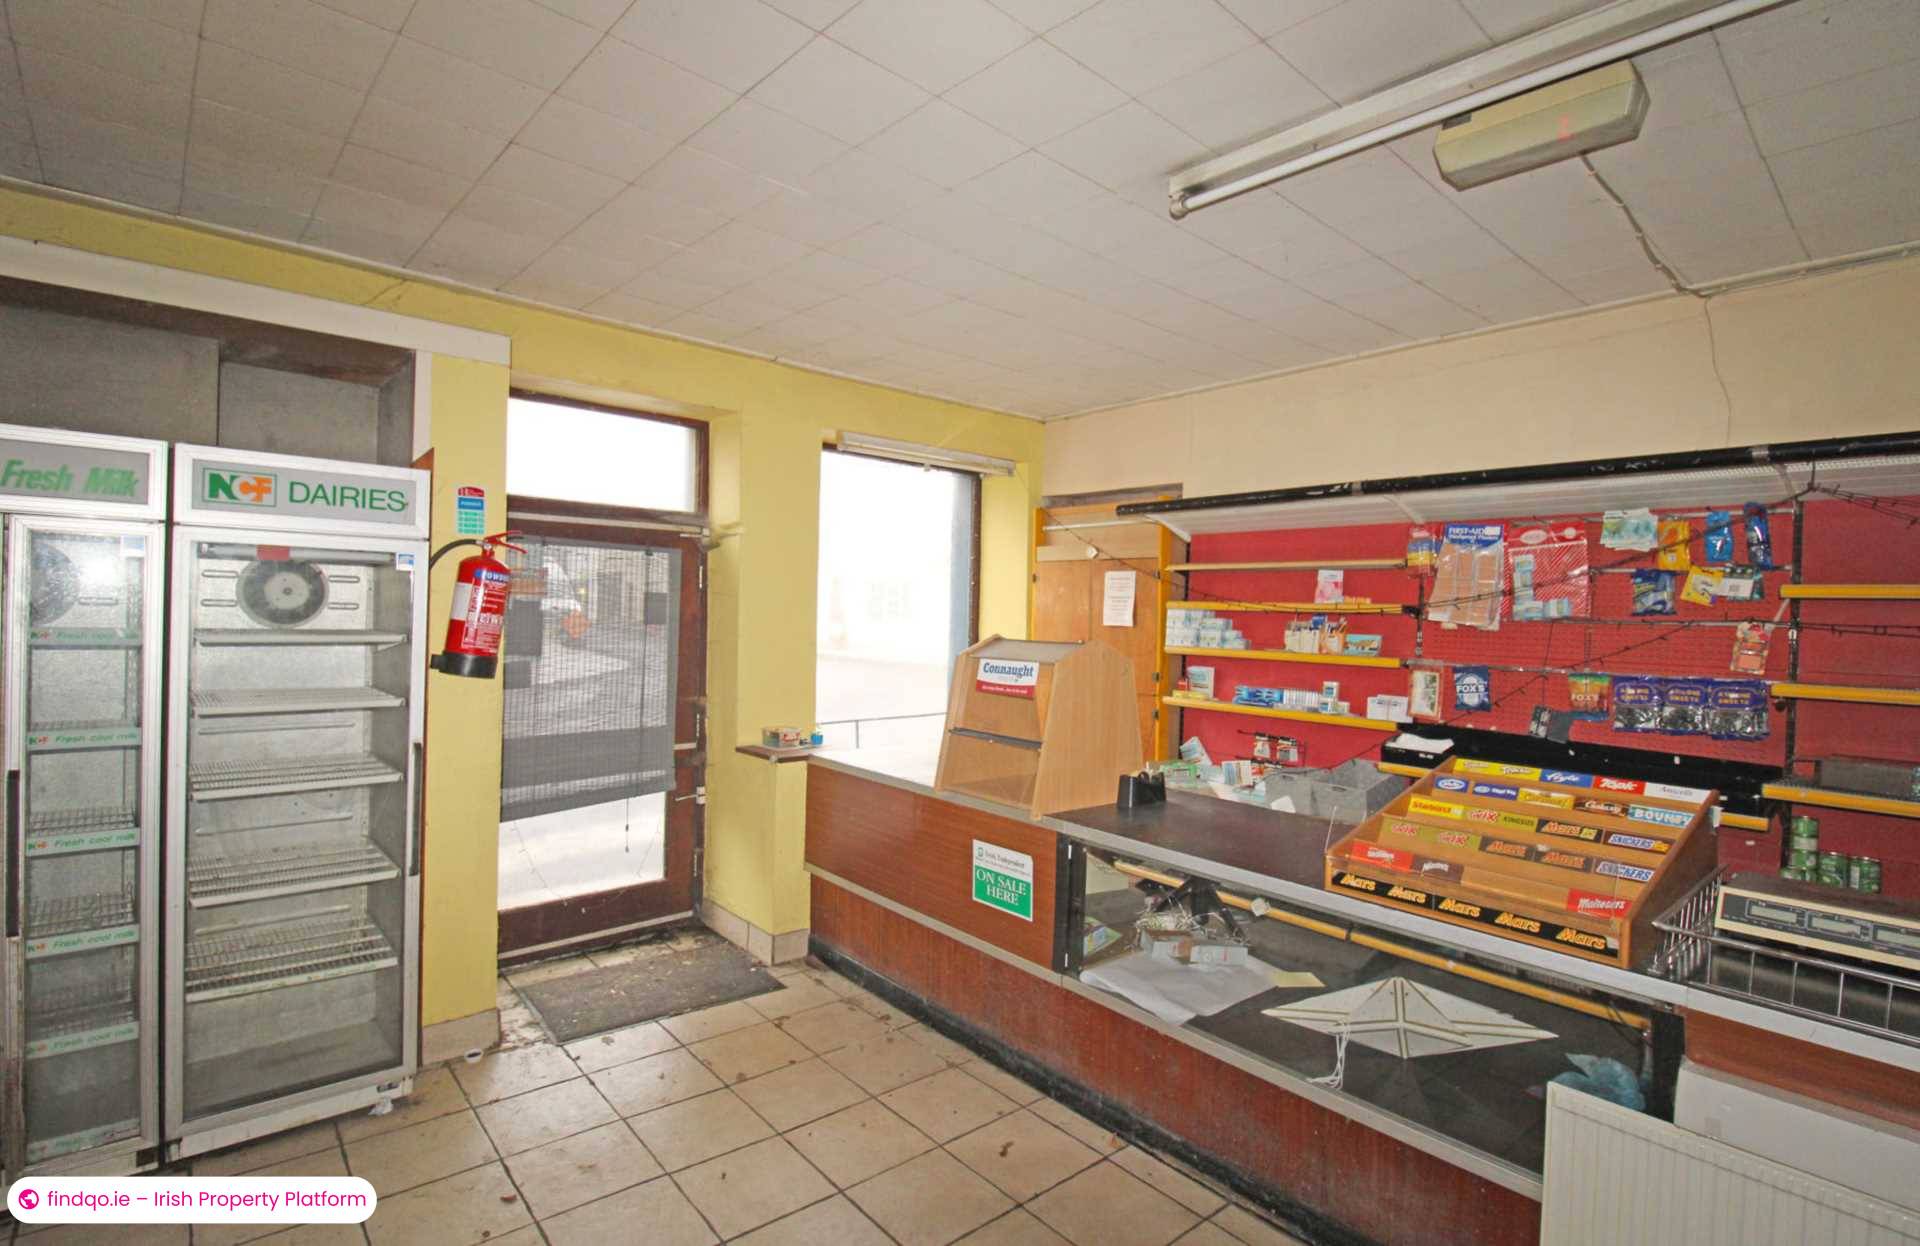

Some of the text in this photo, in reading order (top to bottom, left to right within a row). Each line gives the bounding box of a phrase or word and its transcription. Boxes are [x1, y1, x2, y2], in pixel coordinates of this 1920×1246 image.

[0, 458, 139, 497] Fresh Milk
[208, 472, 409, 513] NCF DAIRIES
[983, 662, 1034, 679] Connaught
[976, 869, 1027, 896] ON SALE
[1340, 873, 1377, 892] Mars
[986, 885, 1019, 906] HERE
[1387, 885, 1427, 904] Mars
[1439, 897, 1481, 918] Mars
[1495, 911, 1542, 933] Mars
[1555, 927, 1607, 950] Mars
